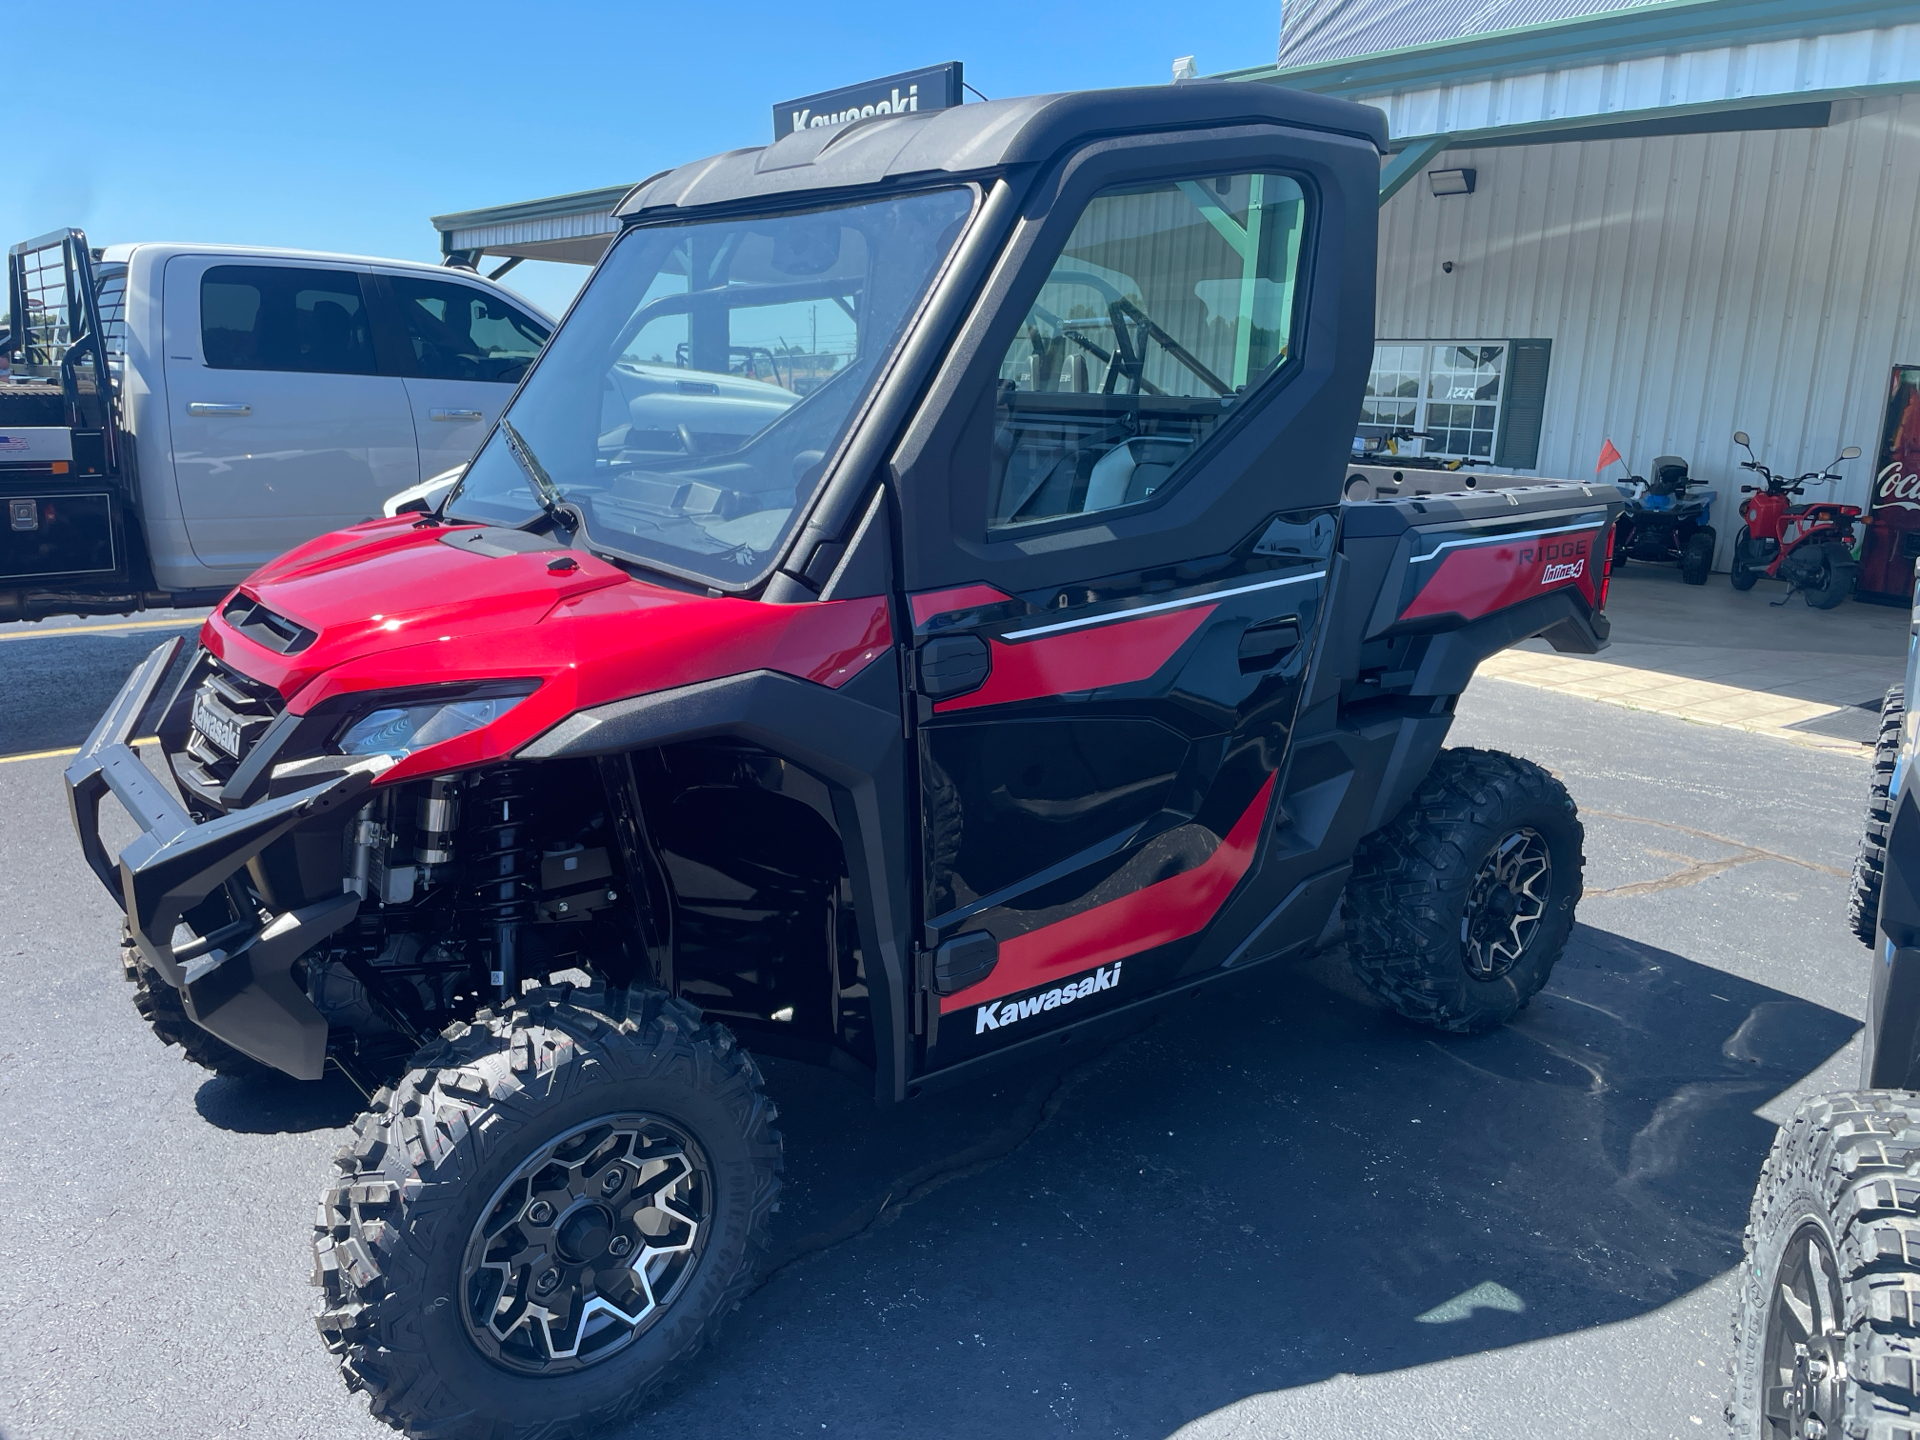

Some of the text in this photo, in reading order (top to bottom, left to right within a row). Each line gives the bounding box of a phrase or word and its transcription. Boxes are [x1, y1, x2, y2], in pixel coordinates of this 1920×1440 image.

[1518, 539, 1587, 566] RIDGE
[191, 692, 241, 757] Kawasaki
[975, 961, 1122, 1035] Kawasaki
